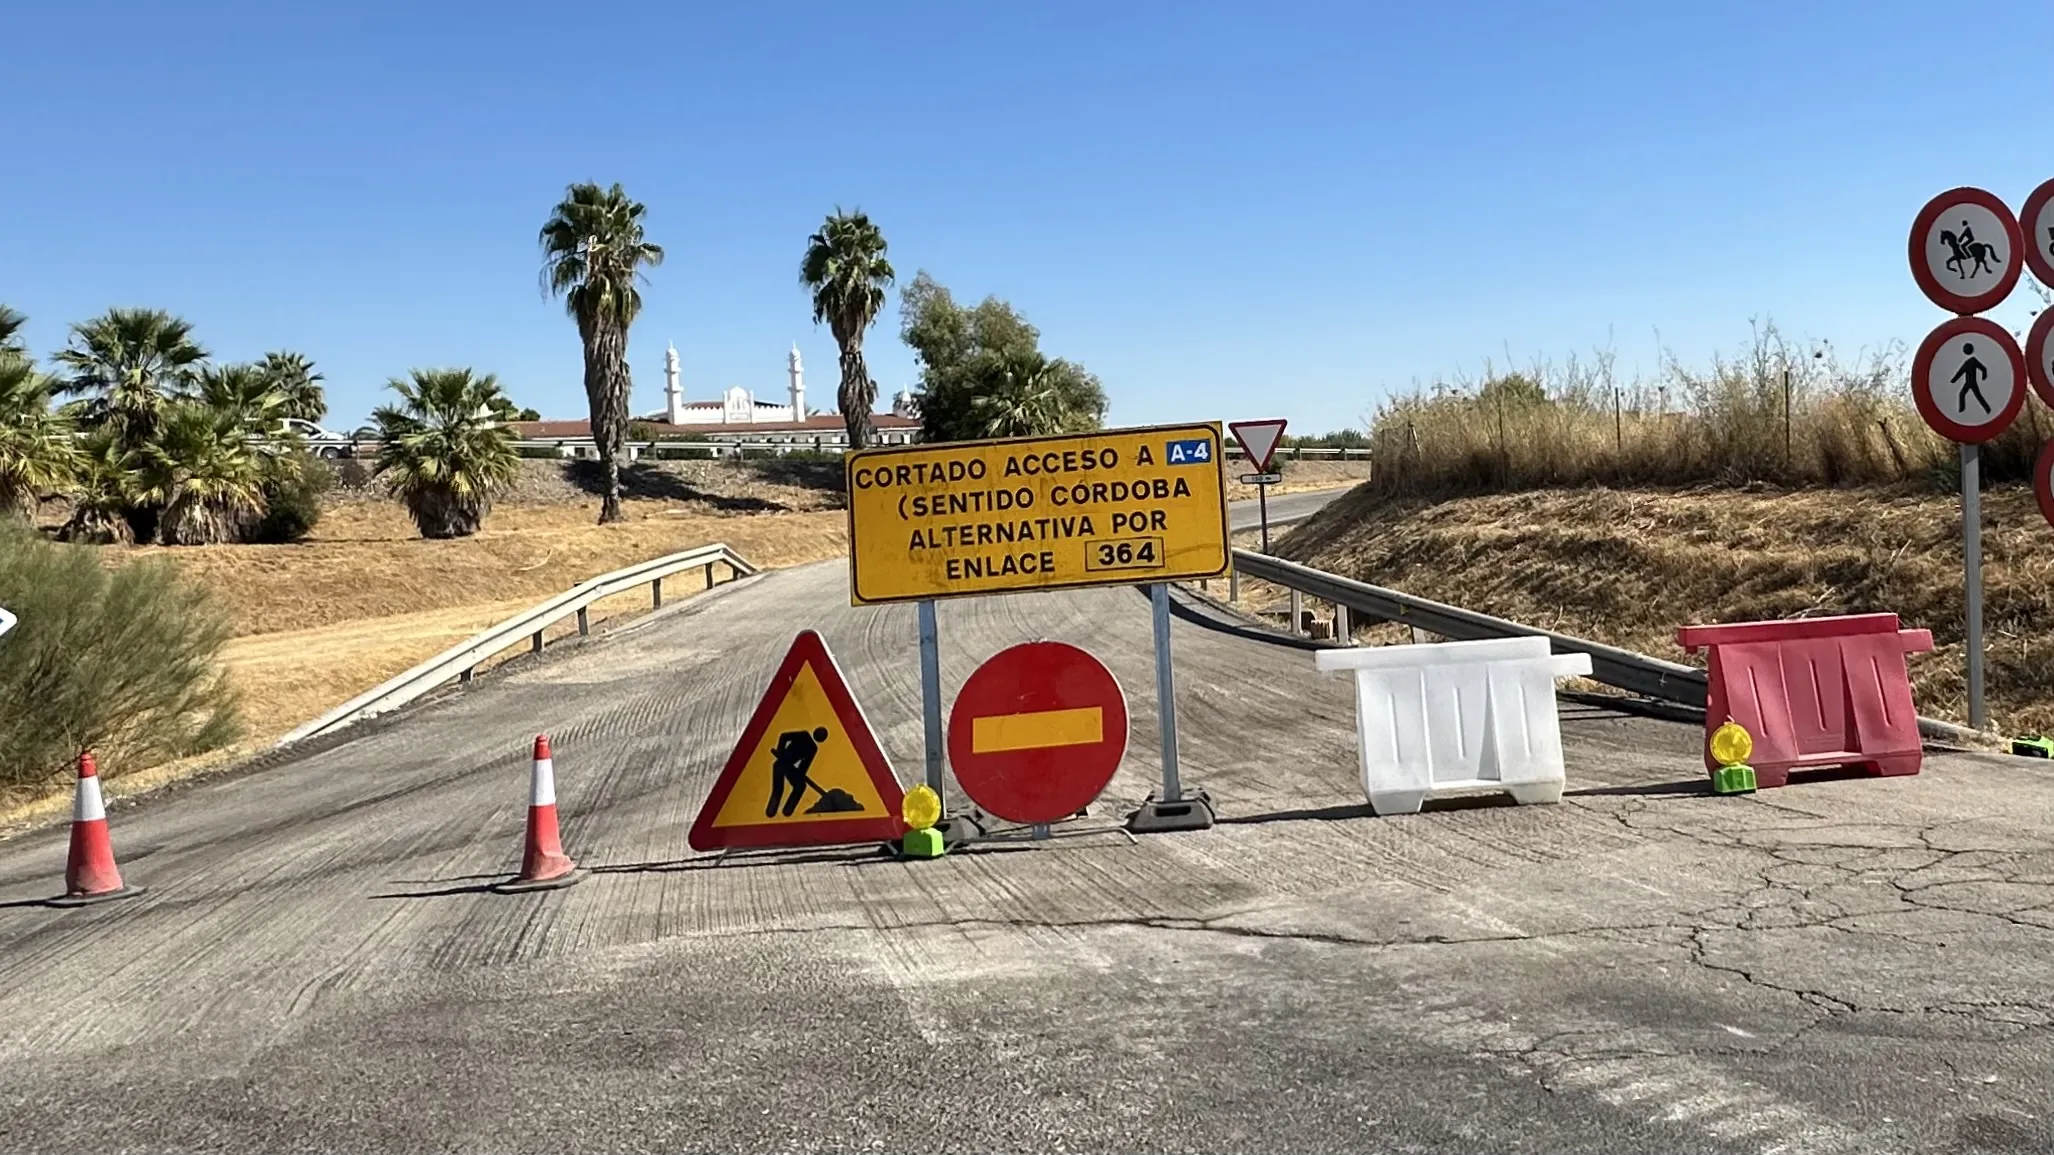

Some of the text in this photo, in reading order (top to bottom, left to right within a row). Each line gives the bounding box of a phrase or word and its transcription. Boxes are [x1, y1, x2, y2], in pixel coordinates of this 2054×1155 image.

[855, 441, 1209, 489] CORTADO ACCESO A A-4
[1051, 477, 1190, 506] CÓRDOBA
[910, 510, 1168, 550] ALTERNATIVA POR
[946, 542, 1156, 580] ENLACE 364
